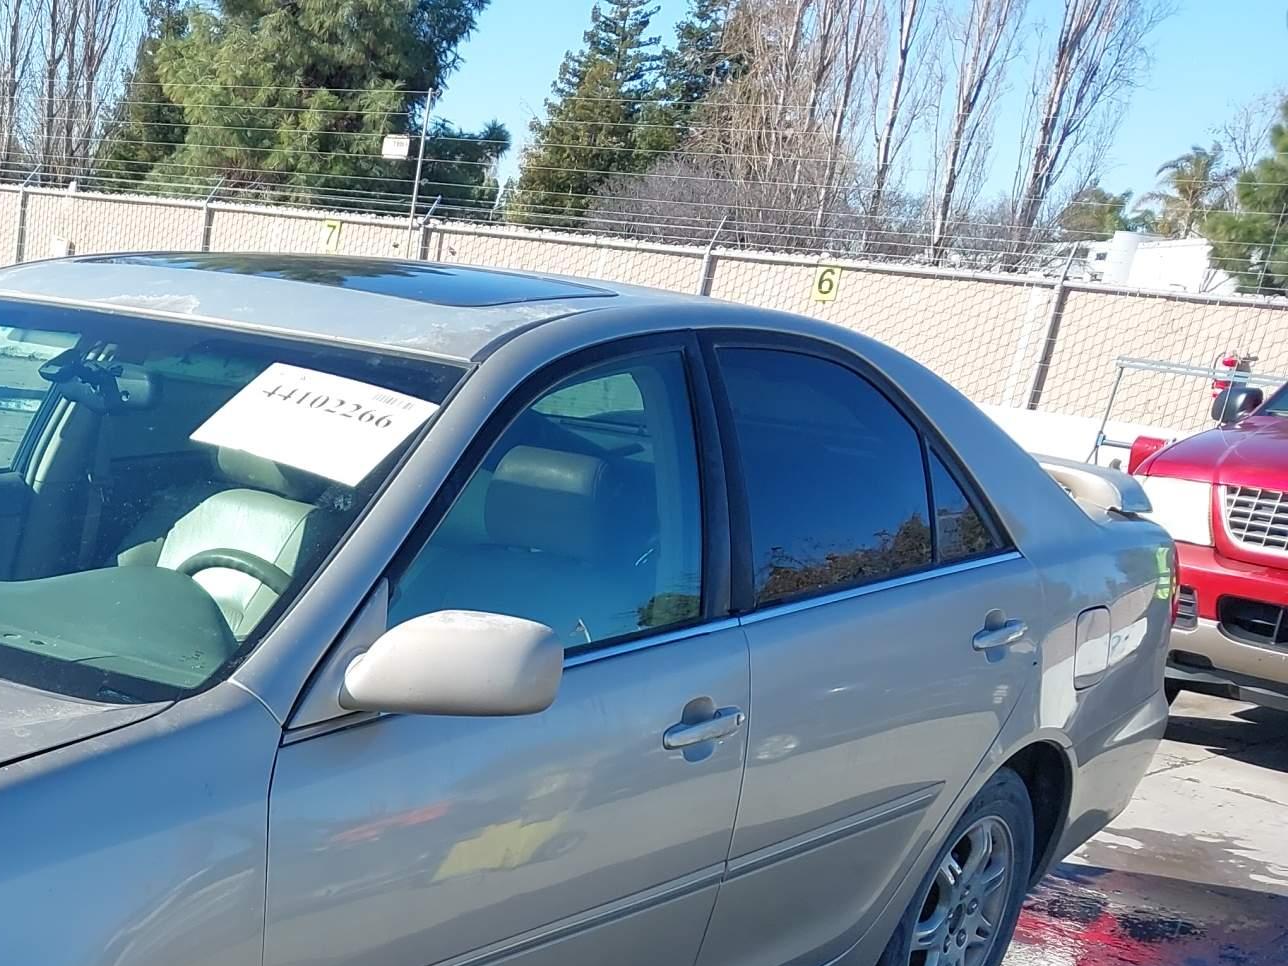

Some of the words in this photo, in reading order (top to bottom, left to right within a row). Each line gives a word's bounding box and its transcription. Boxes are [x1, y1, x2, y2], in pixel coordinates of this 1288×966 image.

[326, 224, 337, 245] 7
[817, 268, 836, 295] 6
[262, 384, 393, 429] 44102266
